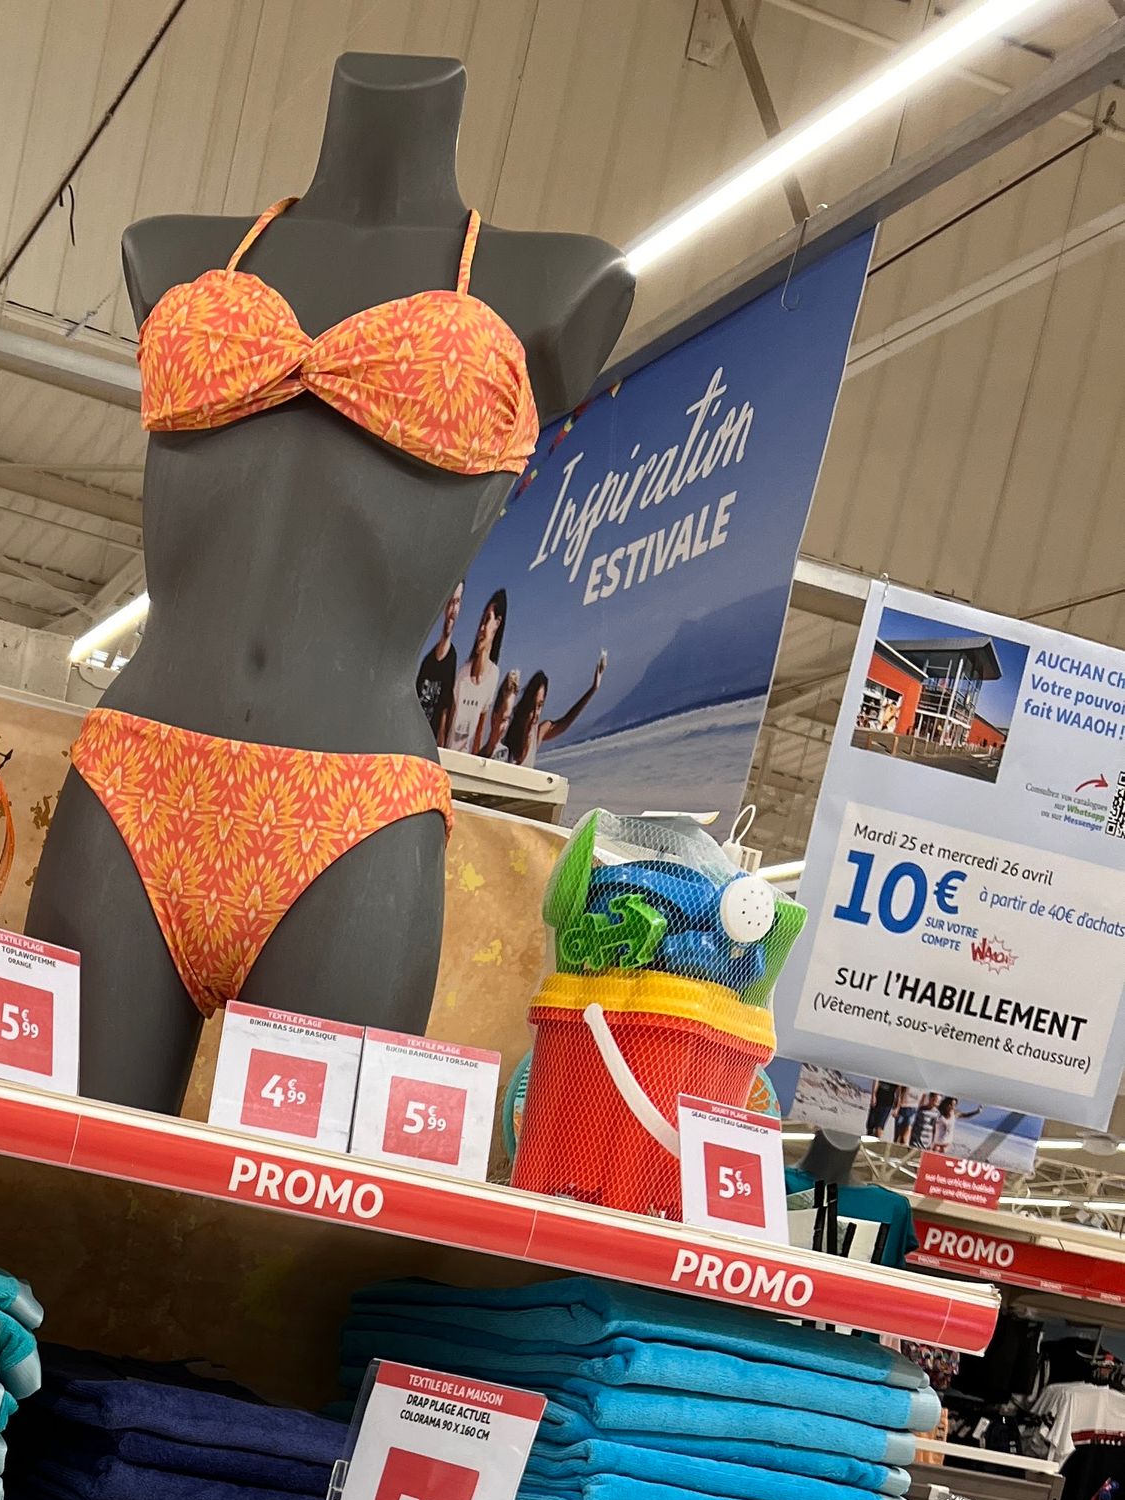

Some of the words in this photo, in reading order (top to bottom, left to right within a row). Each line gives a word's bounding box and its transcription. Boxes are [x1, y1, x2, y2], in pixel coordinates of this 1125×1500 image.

[529, 366, 755, 583] Inspiration
[582, 490, 738, 606] ESTIVALE
[1035, 650, 1105, 683] AUCHAN
[1031, 674, 1073, 700] Votre
[1024, 698, 1053, 721] fait
[1056, 707, 1118, 739] WAAOH
[854, 822, 897, 847] Mardi
[899, 834, 916, 851] 25
[920, 842, 934, 857] et
[937, 848, 999, 872] mercredi
[1003, 860, 1019, 878] 26
[1021, 868, 1053, 886] avril
[979, 886, 988, 902] à
[989, 892, 1026, 913] partir
[1029, 899, 1045, 917] de
[1048, 906, 1076, 924] 40€
[921, 932, 962, 952] COMPTE
[925, 916, 946, 931] SUR
[946, 922, 979, 939] VOTRE
[23, 940, 45, 954] PLAGE
[7, 957, 32, 970] ORANGE
[267, 1011, 298, 1025] TEXTILE
[299, 1018, 323, 1029] PLAGE
[835, 967, 877, 993] sur
[883, 970, 1088, 1042] l'HABILLEMENT
[249, 1018, 272, 1029] BIKINI
[272, 1023, 288, 1033] BAS
[288, 1026, 305, 1035] SLIP
[305, 1030, 338, 1042] BASIQUE
[813, 991, 892, 1027] (Vêtement,
[895, 1013, 1000, 1051] sous-vêtement
[1002, 1037, 1015, 1053] &
[1016, 1042, 1091, 1074] chaussure)
[407, 1038, 436, 1052] TEXTILE
[436, 1045, 461, 1056] PLAGE
[408, 1050, 444, 1063] BANDEAU
[445, 1056, 479, 1069] TORSADE
[227, 1156, 384, 1219] PROMO
[924, 1227, 1015, 1268] PROMO
[670, 1248, 814, 1308] PROMO
[408, 1374, 441, 1392] TEXTILE
[441, 1382, 453, 1394] DE
[454, 1385, 466, 1397] LA
[467, 1388, 503, 1406] MAISON
[400, 1409, 441, 1429] COLORAMA
[441, 1419, 452, 1431] 90
[453, 1422, 460, 1433] X
[461, 1424, 476, 1438] 160
[476, 1428, 489, 1441] CM
[406, 1394, 429, 1409] DRAP
[429, 1399, 456, 1416] PLAGE
[457, 1406, 491, 1424] ACTUEL
